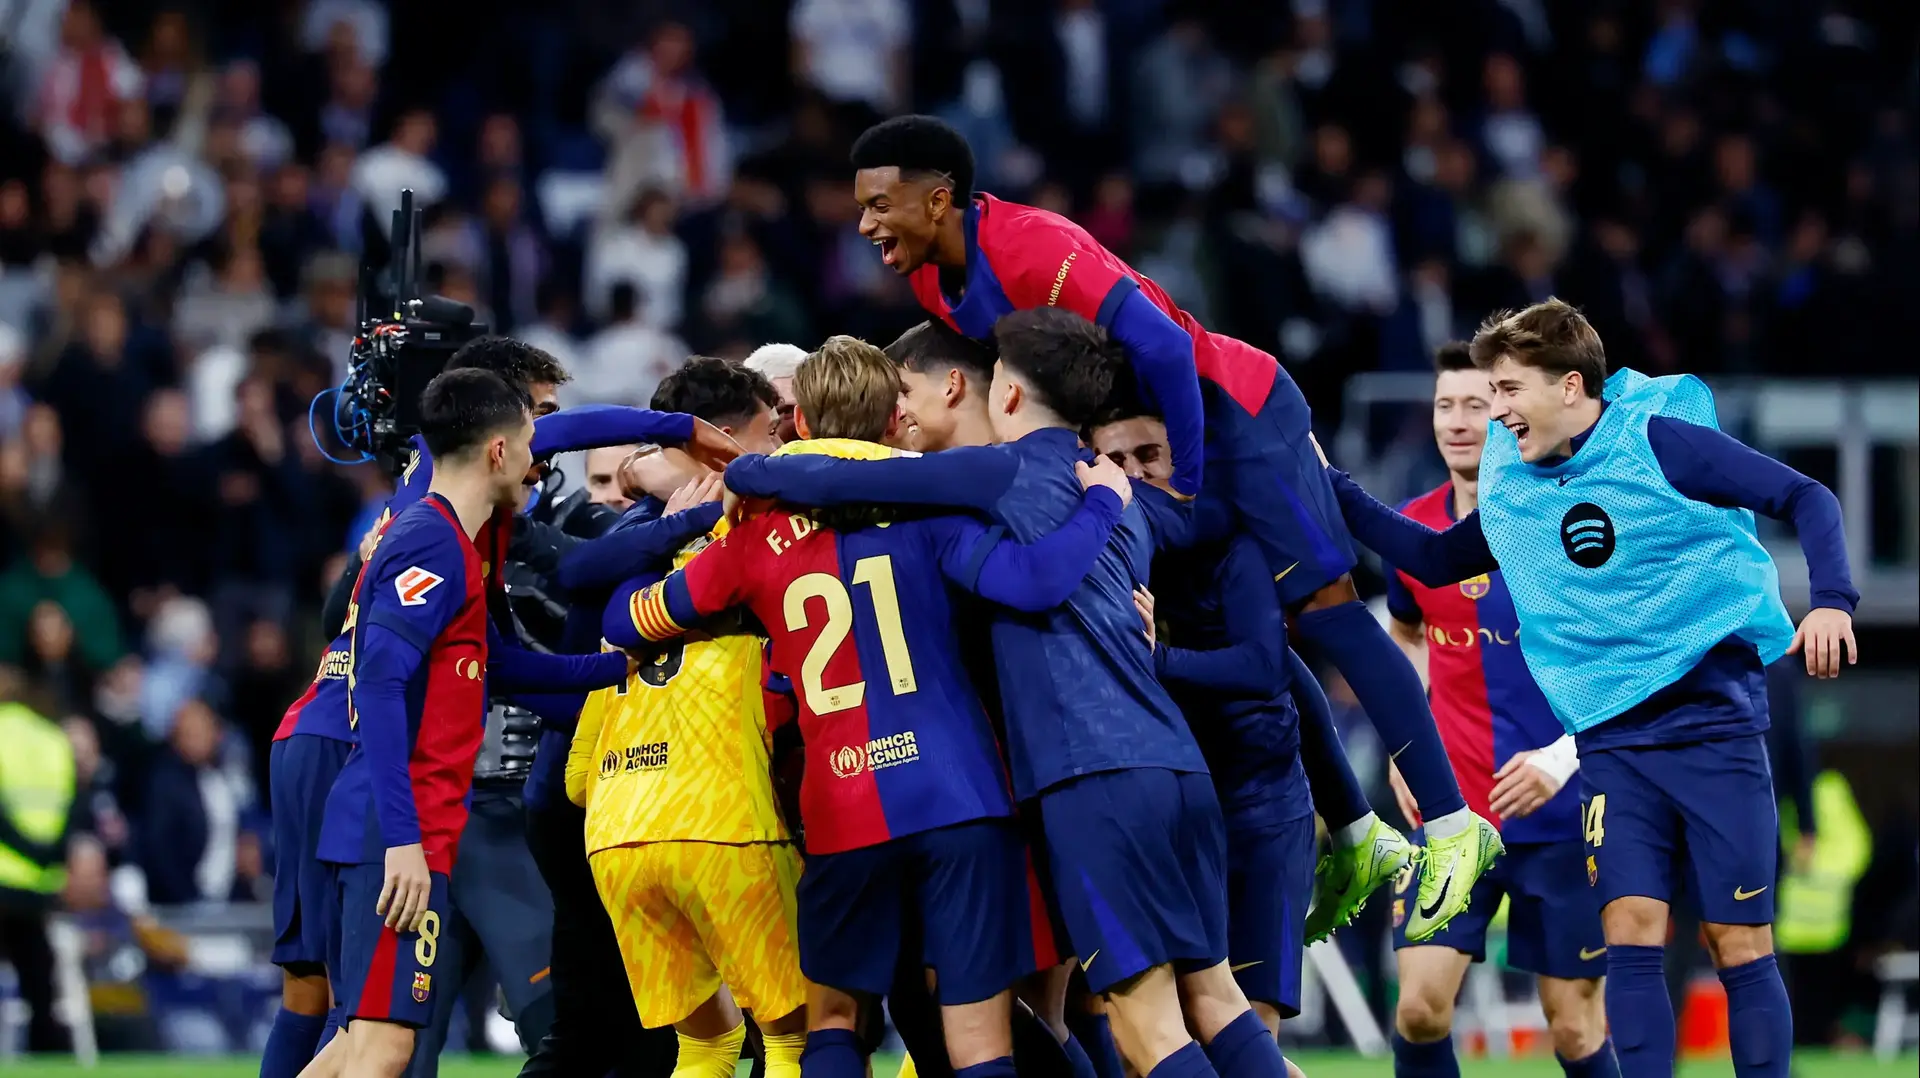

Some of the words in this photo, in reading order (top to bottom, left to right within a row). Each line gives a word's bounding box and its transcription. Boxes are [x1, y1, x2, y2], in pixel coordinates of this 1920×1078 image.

[1047, 259, 1072, 308] AMBILIGHT
[1067, 251, 1077, 261] tv
[766, 528, 792, 556] F.
[782, 554, 918, 716] 21
[625, 741, 669, 759] UNHCR
[865, 731, 916, 755] UNHCR
[866, 743, 919, 768] ACNUR
[625, 754, 668, 771] ACNUR
[1581, 793, 1606, 848] 4
[414, 909, 440, 968] 8
